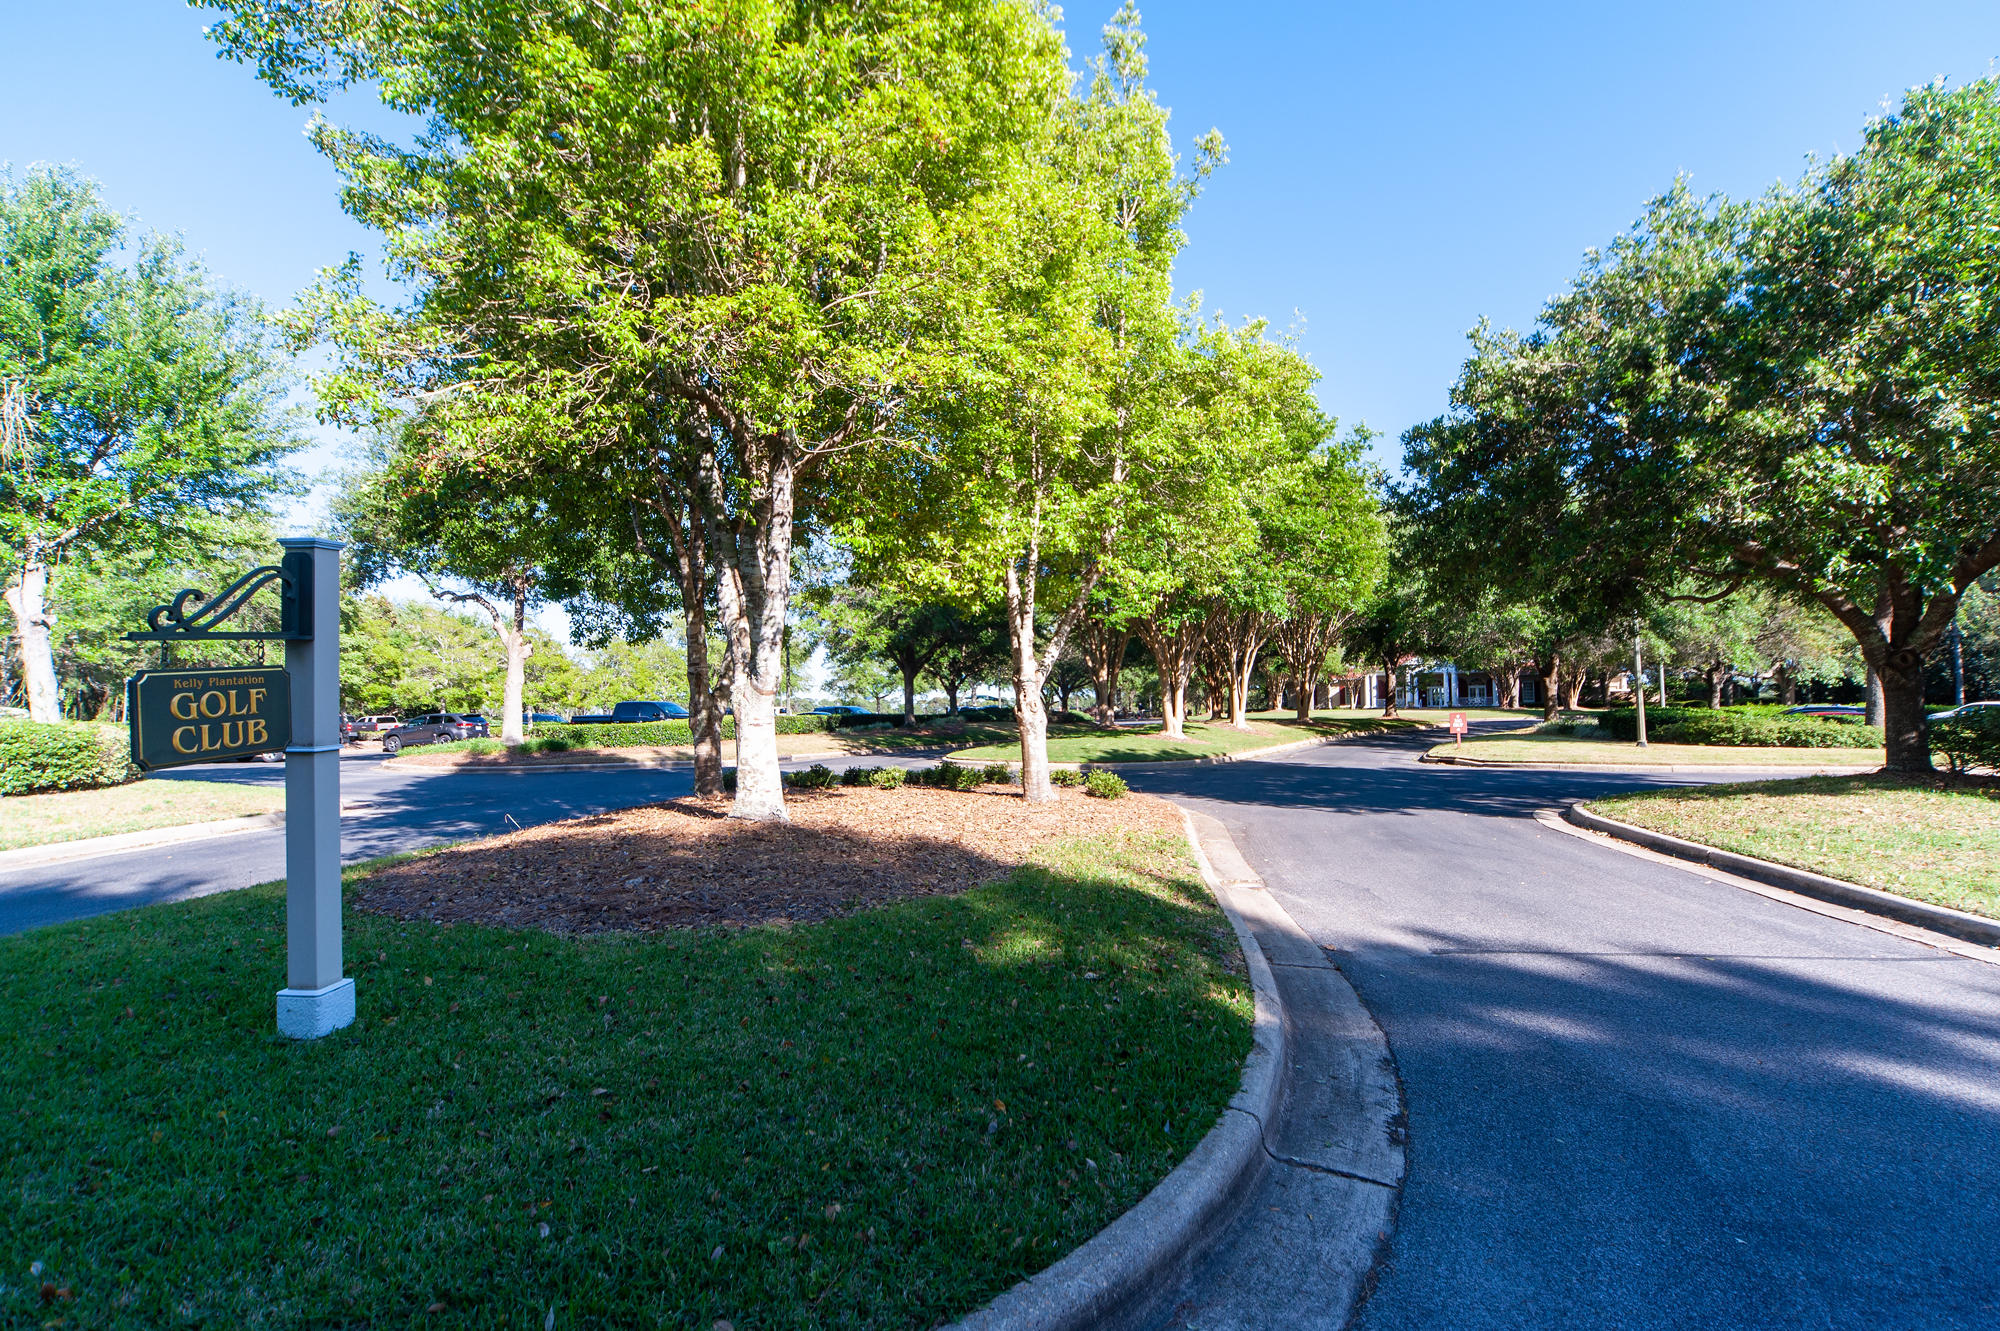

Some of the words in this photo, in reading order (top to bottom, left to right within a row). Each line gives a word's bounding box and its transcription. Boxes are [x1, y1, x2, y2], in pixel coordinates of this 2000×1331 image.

[174, 679, 203, 689] Kelly
[209, 676, 264, 686] Plantation
[170, 688, 267, 720] GOLF
[172, 719, 268, 754] CLUB
